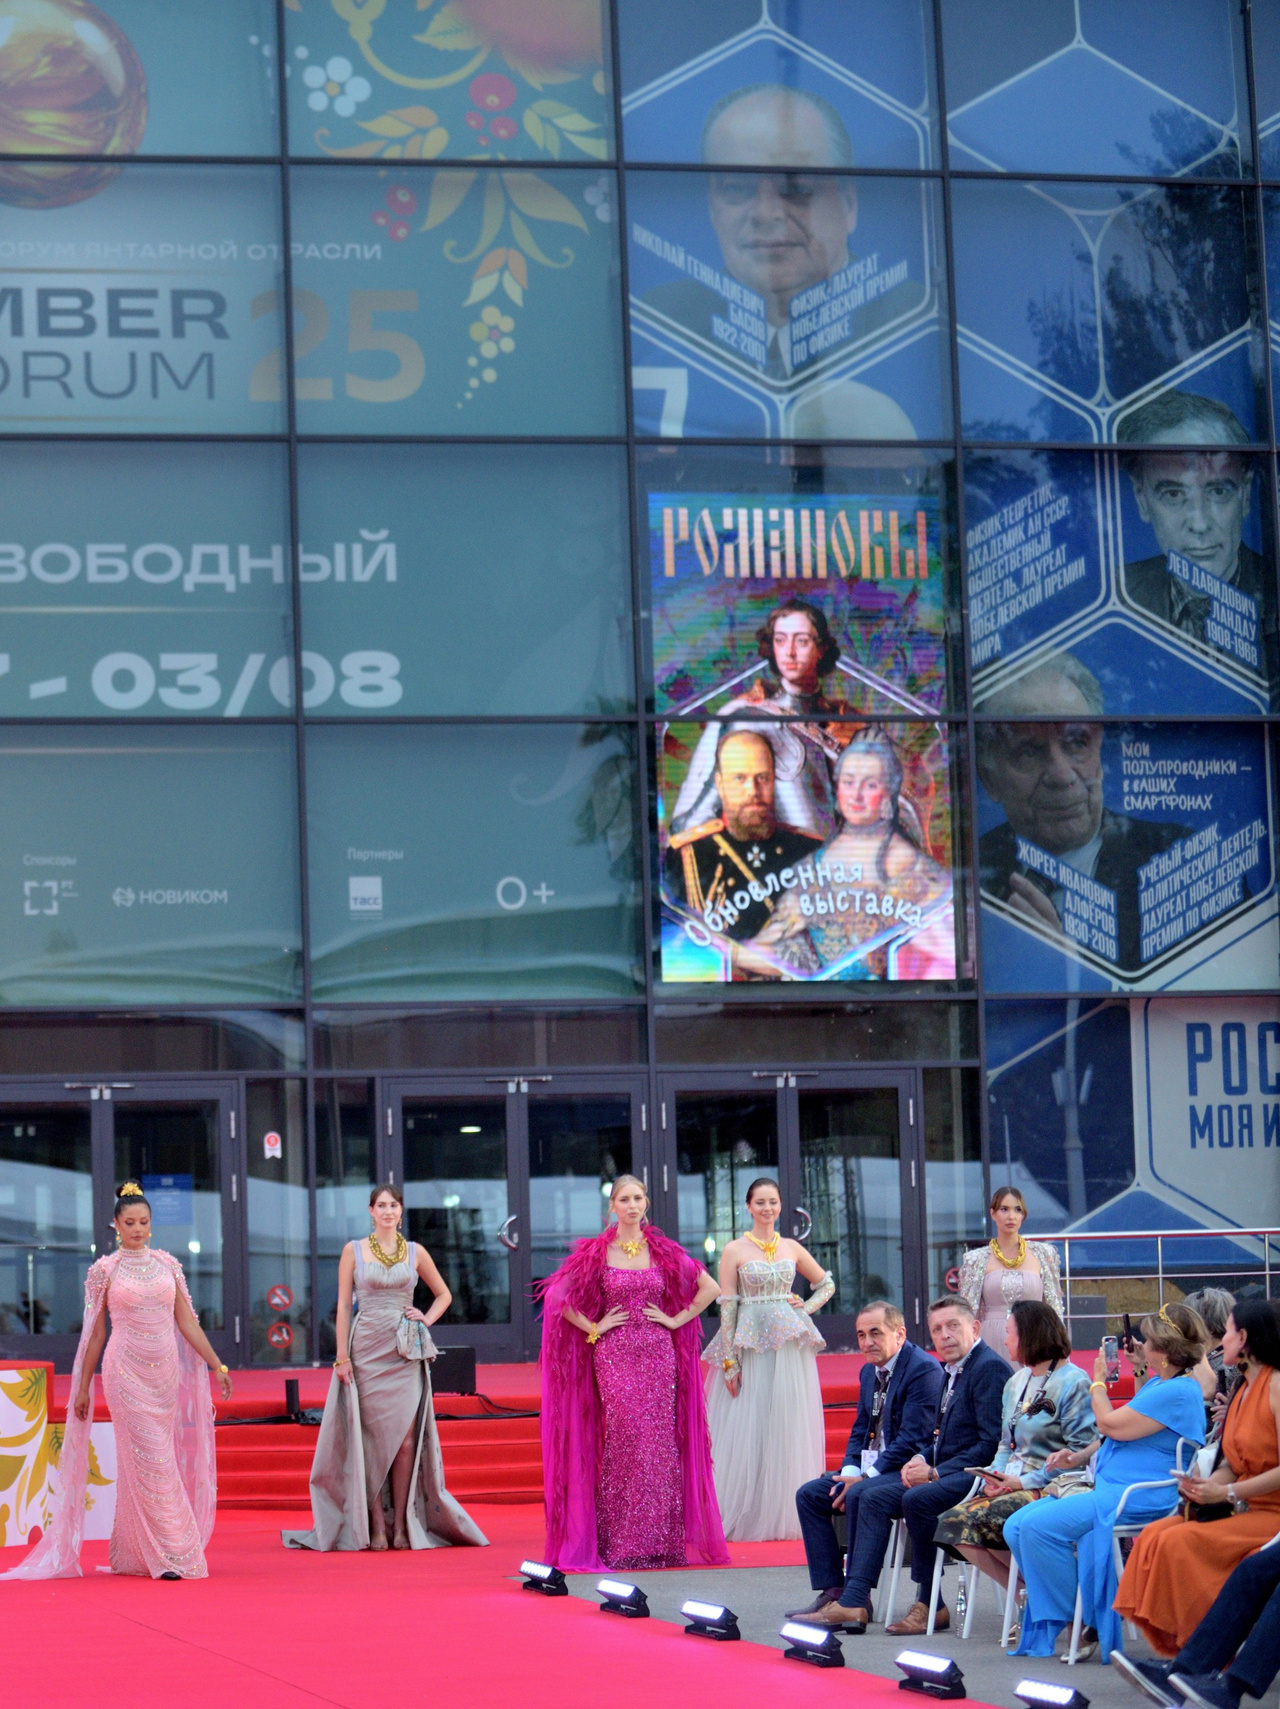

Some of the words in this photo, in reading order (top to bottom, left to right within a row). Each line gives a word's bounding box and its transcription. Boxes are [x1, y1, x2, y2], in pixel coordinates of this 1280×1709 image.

[82, 238, 238, 260] ЯНТАРНОЙ
[249, 286, 426, 403] 25
[729, 302, 766, 341] БАСОВ
[967, 521, 1025, 573] АКАДЕМИК
[1027, 514, 1042, 538] АН
[968, 525, 1051, 597] ОБЩЕСТВЕННЫЙ
[1021, 544, 1067, 590] ЛАУРЕАТ
[970, 577, 1043, 643] НОБЕЛЕВСКОЙ
[1044, 557, 1086, 599] ПРЕМИИ
[1168, 551, 1189, 580] ЛЕВ
[1191, 566, 1257, 621] ДАВИДОВИЧ
[1212, 601, 1257, 641] ЛАНДАУ
[970, 632, 1002, 667] МИРА
[91, 650, 403, 718] 03/08
[1122, 742, 1150, 758] МОИ
[1122, 760, 1237, 779] ПОЛУПРОВОДНИКИ
[1123, 795, 1213, 811] СМАРТФОНАХ
[347, 847, 404, 861] Партнеры
[1018, 839, 1057, 879] ЖОРЕС
[1059, 863, 1115, 913] ИВАНОВИЧ
[139, 889, 228, 905] НОВИКОМ
[1141, 843, 1218, 913] ПОЛИТИЧЕСКИЙ
[1142, 890, 1187, 936] ЛАУРЕАТ
[1189, 841, 1259, 906] НОБЕЛЕВСКОЙ
[1064, 912, 1117, 960] 1930-2019
[1065, 890, 1116, 937] АЛФЁРОВ
[1143, 916, 1184, 960] ПРЕМИИ
[1185, 907, 1199, 932] ПО
[1201, 880, 1241, 921] ФИЗИКЕ
[1186, 1021, 1280, 1097] РОС
[1189, 1103, 1254, 1149] МОЯ
